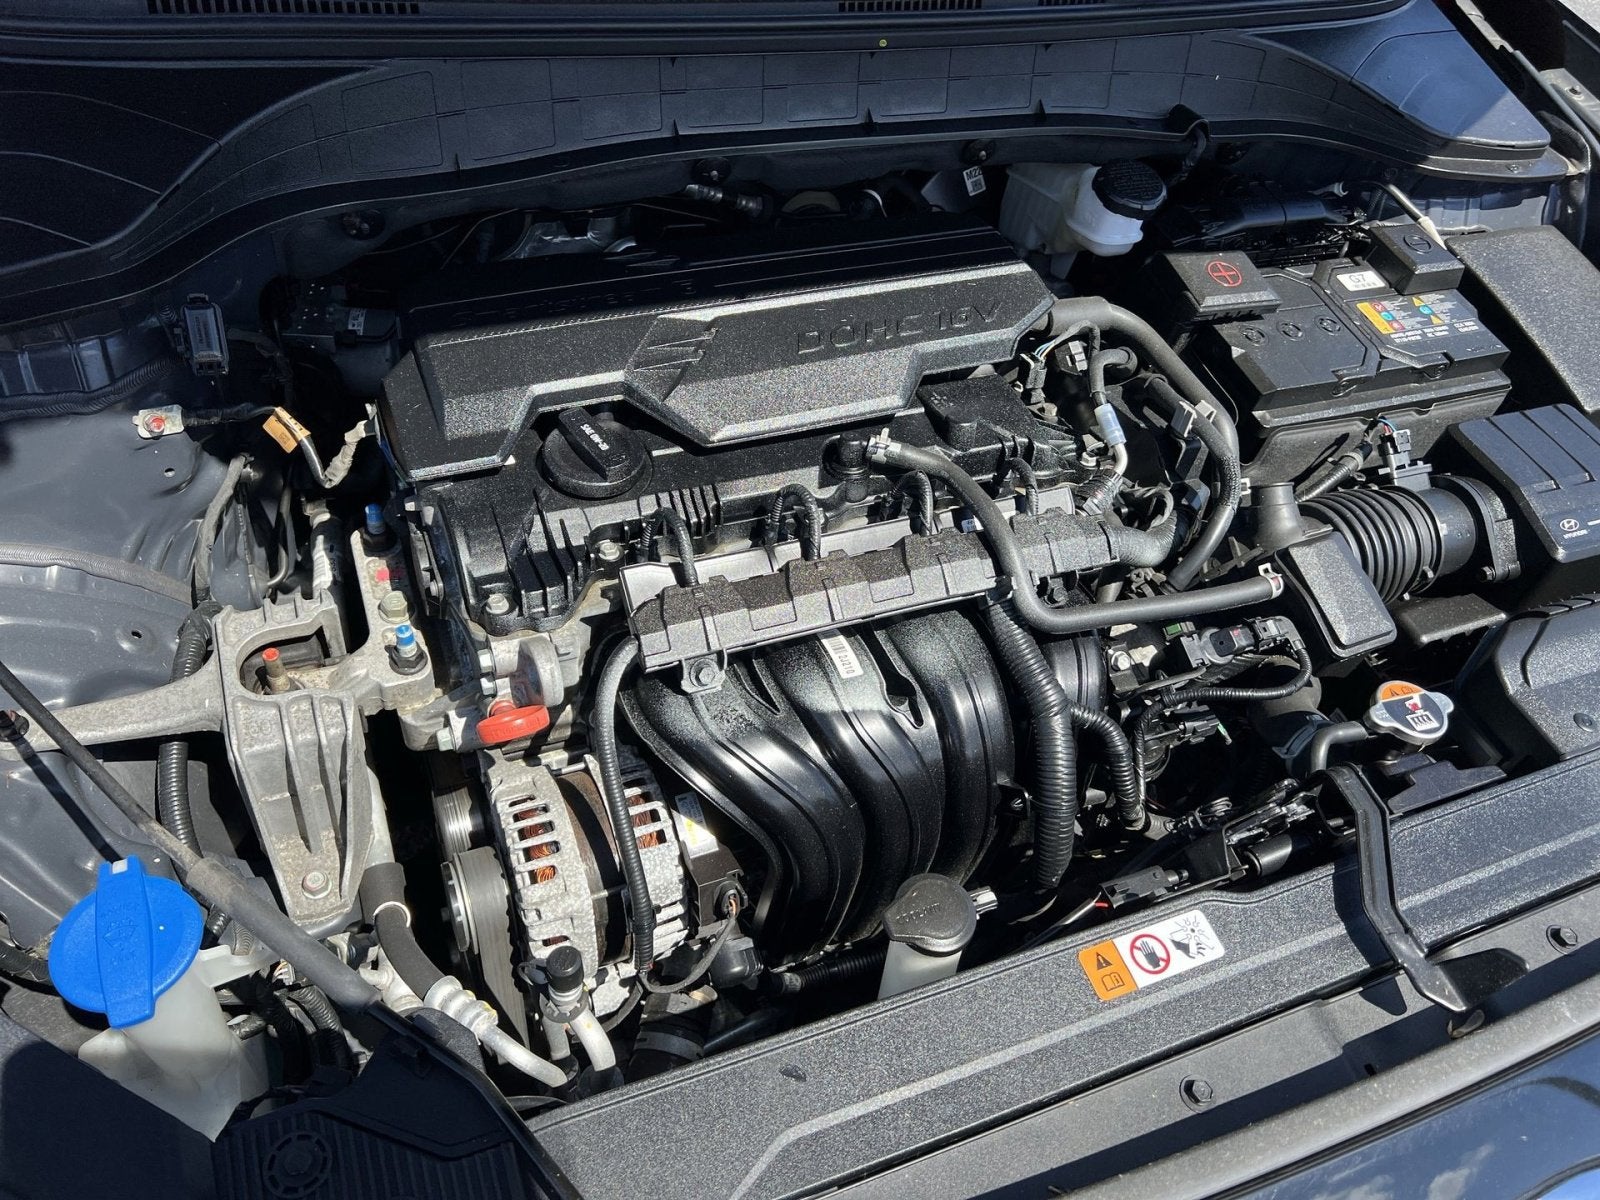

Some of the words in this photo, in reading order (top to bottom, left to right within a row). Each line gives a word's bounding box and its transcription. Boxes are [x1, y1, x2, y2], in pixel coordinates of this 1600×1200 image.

[1349, 274, 1366, 284] G7
[797, 311, 924, 354] DOHC
[931, 299, 1003, 331] 16V
[580, 423, 595, 436] SAE
